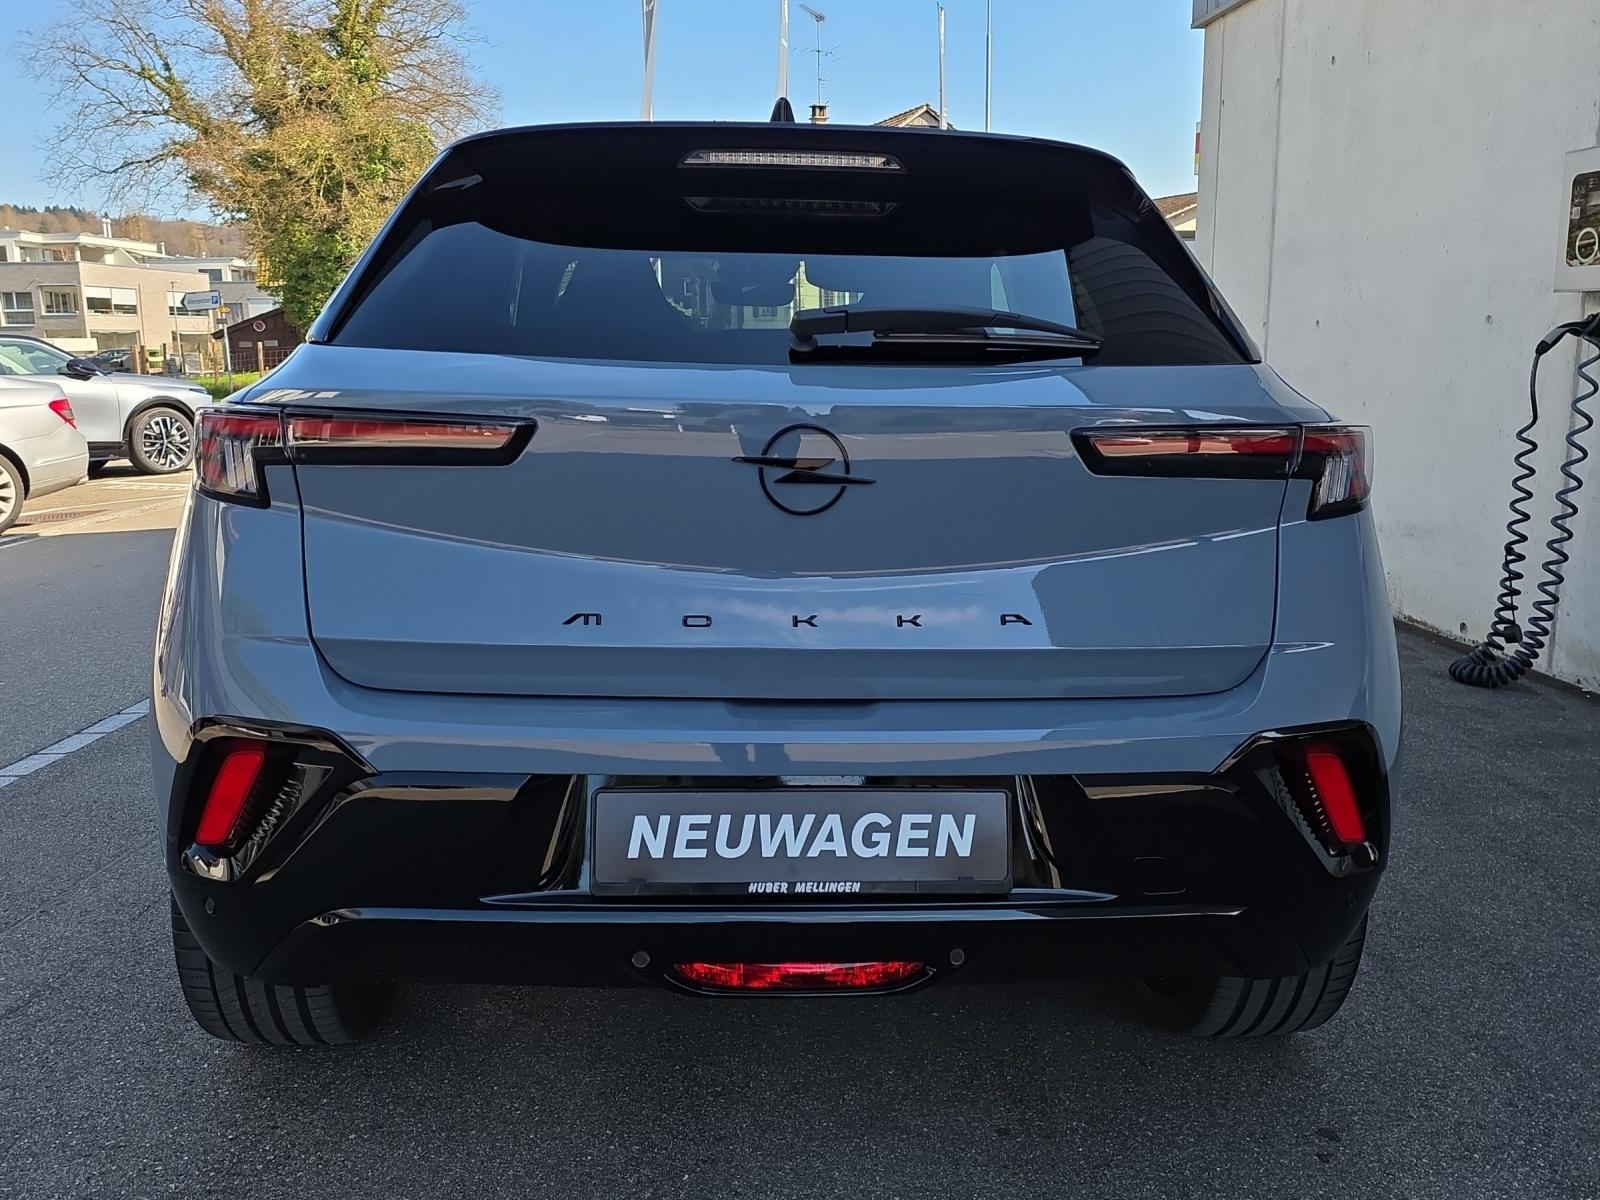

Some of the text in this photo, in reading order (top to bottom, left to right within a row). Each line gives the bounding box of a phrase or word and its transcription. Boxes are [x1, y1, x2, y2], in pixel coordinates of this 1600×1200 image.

[561, 612, 1033, 628] MOKKA
[627, 812, 976, 859] NEUWAGEN
[748, 881, 861, 894] HUBER MELLINGEN
